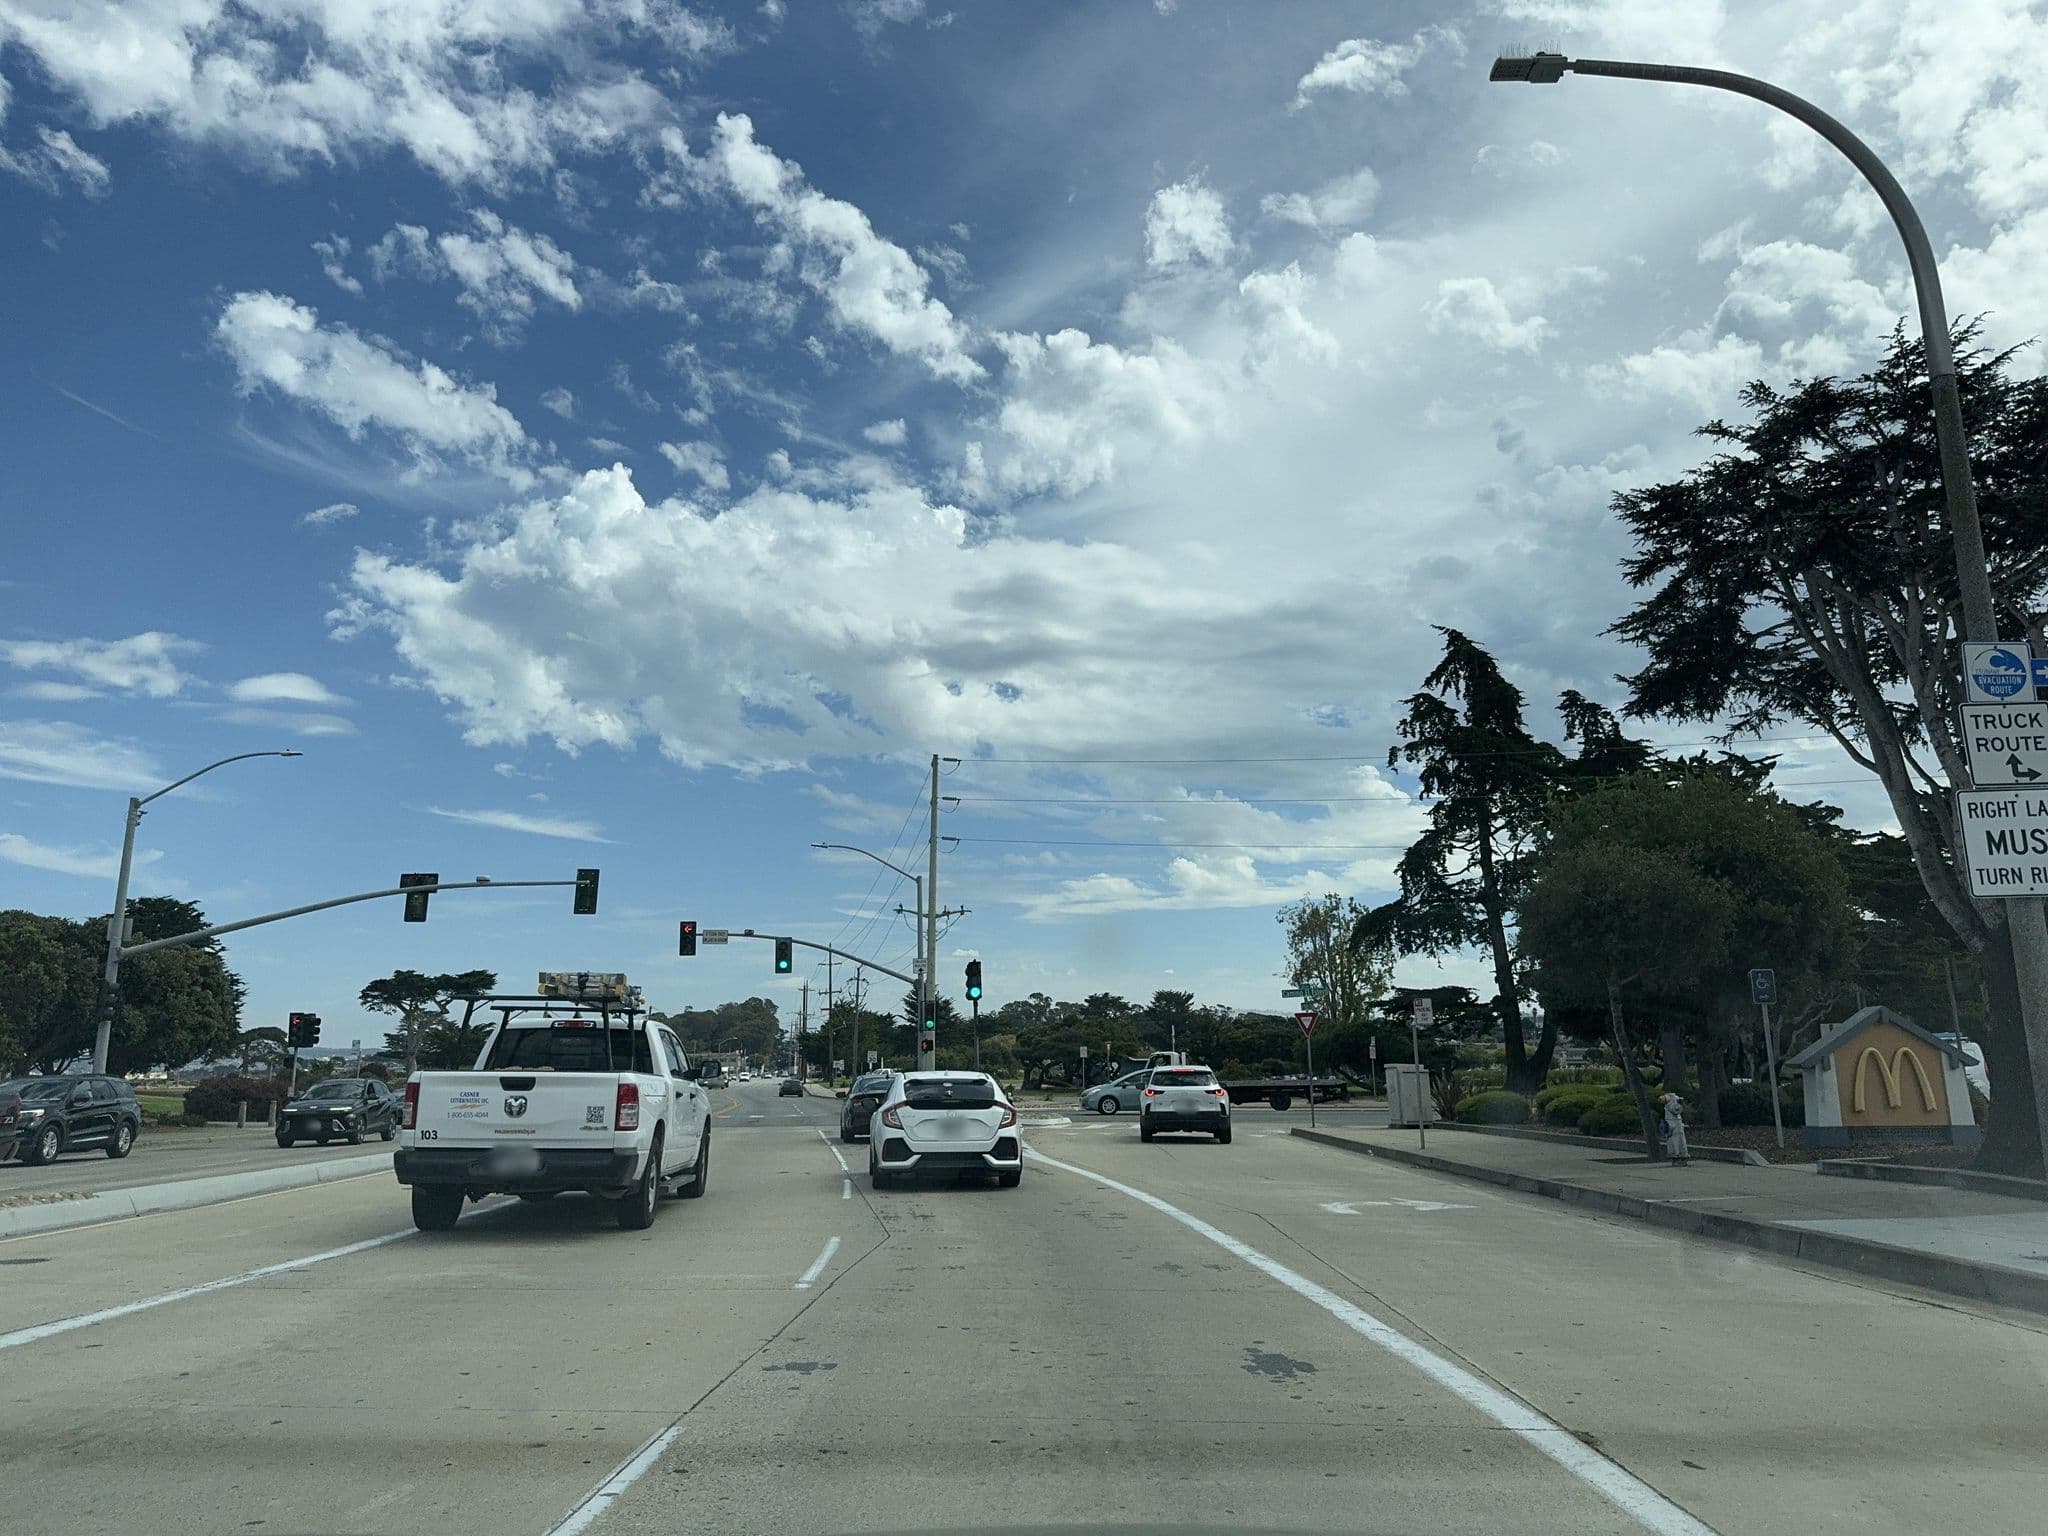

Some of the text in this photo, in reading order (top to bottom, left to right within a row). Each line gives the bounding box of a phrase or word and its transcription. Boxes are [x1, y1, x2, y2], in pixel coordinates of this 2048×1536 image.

[1978, 676, 2022, 684] EVACUATION
[1990, 685, 2013, 694] ROUTE
[1970, 713, 2043, 729] TRUCK
[1975, 736, 2047, 752] ROUTE
[1967, 801, 2017, 818] RIGHT
[1985, 829, 2048, 855] MUS
[1976, 867, 2023, 885] TURN
[420, 1129, 438, 1140] 103
